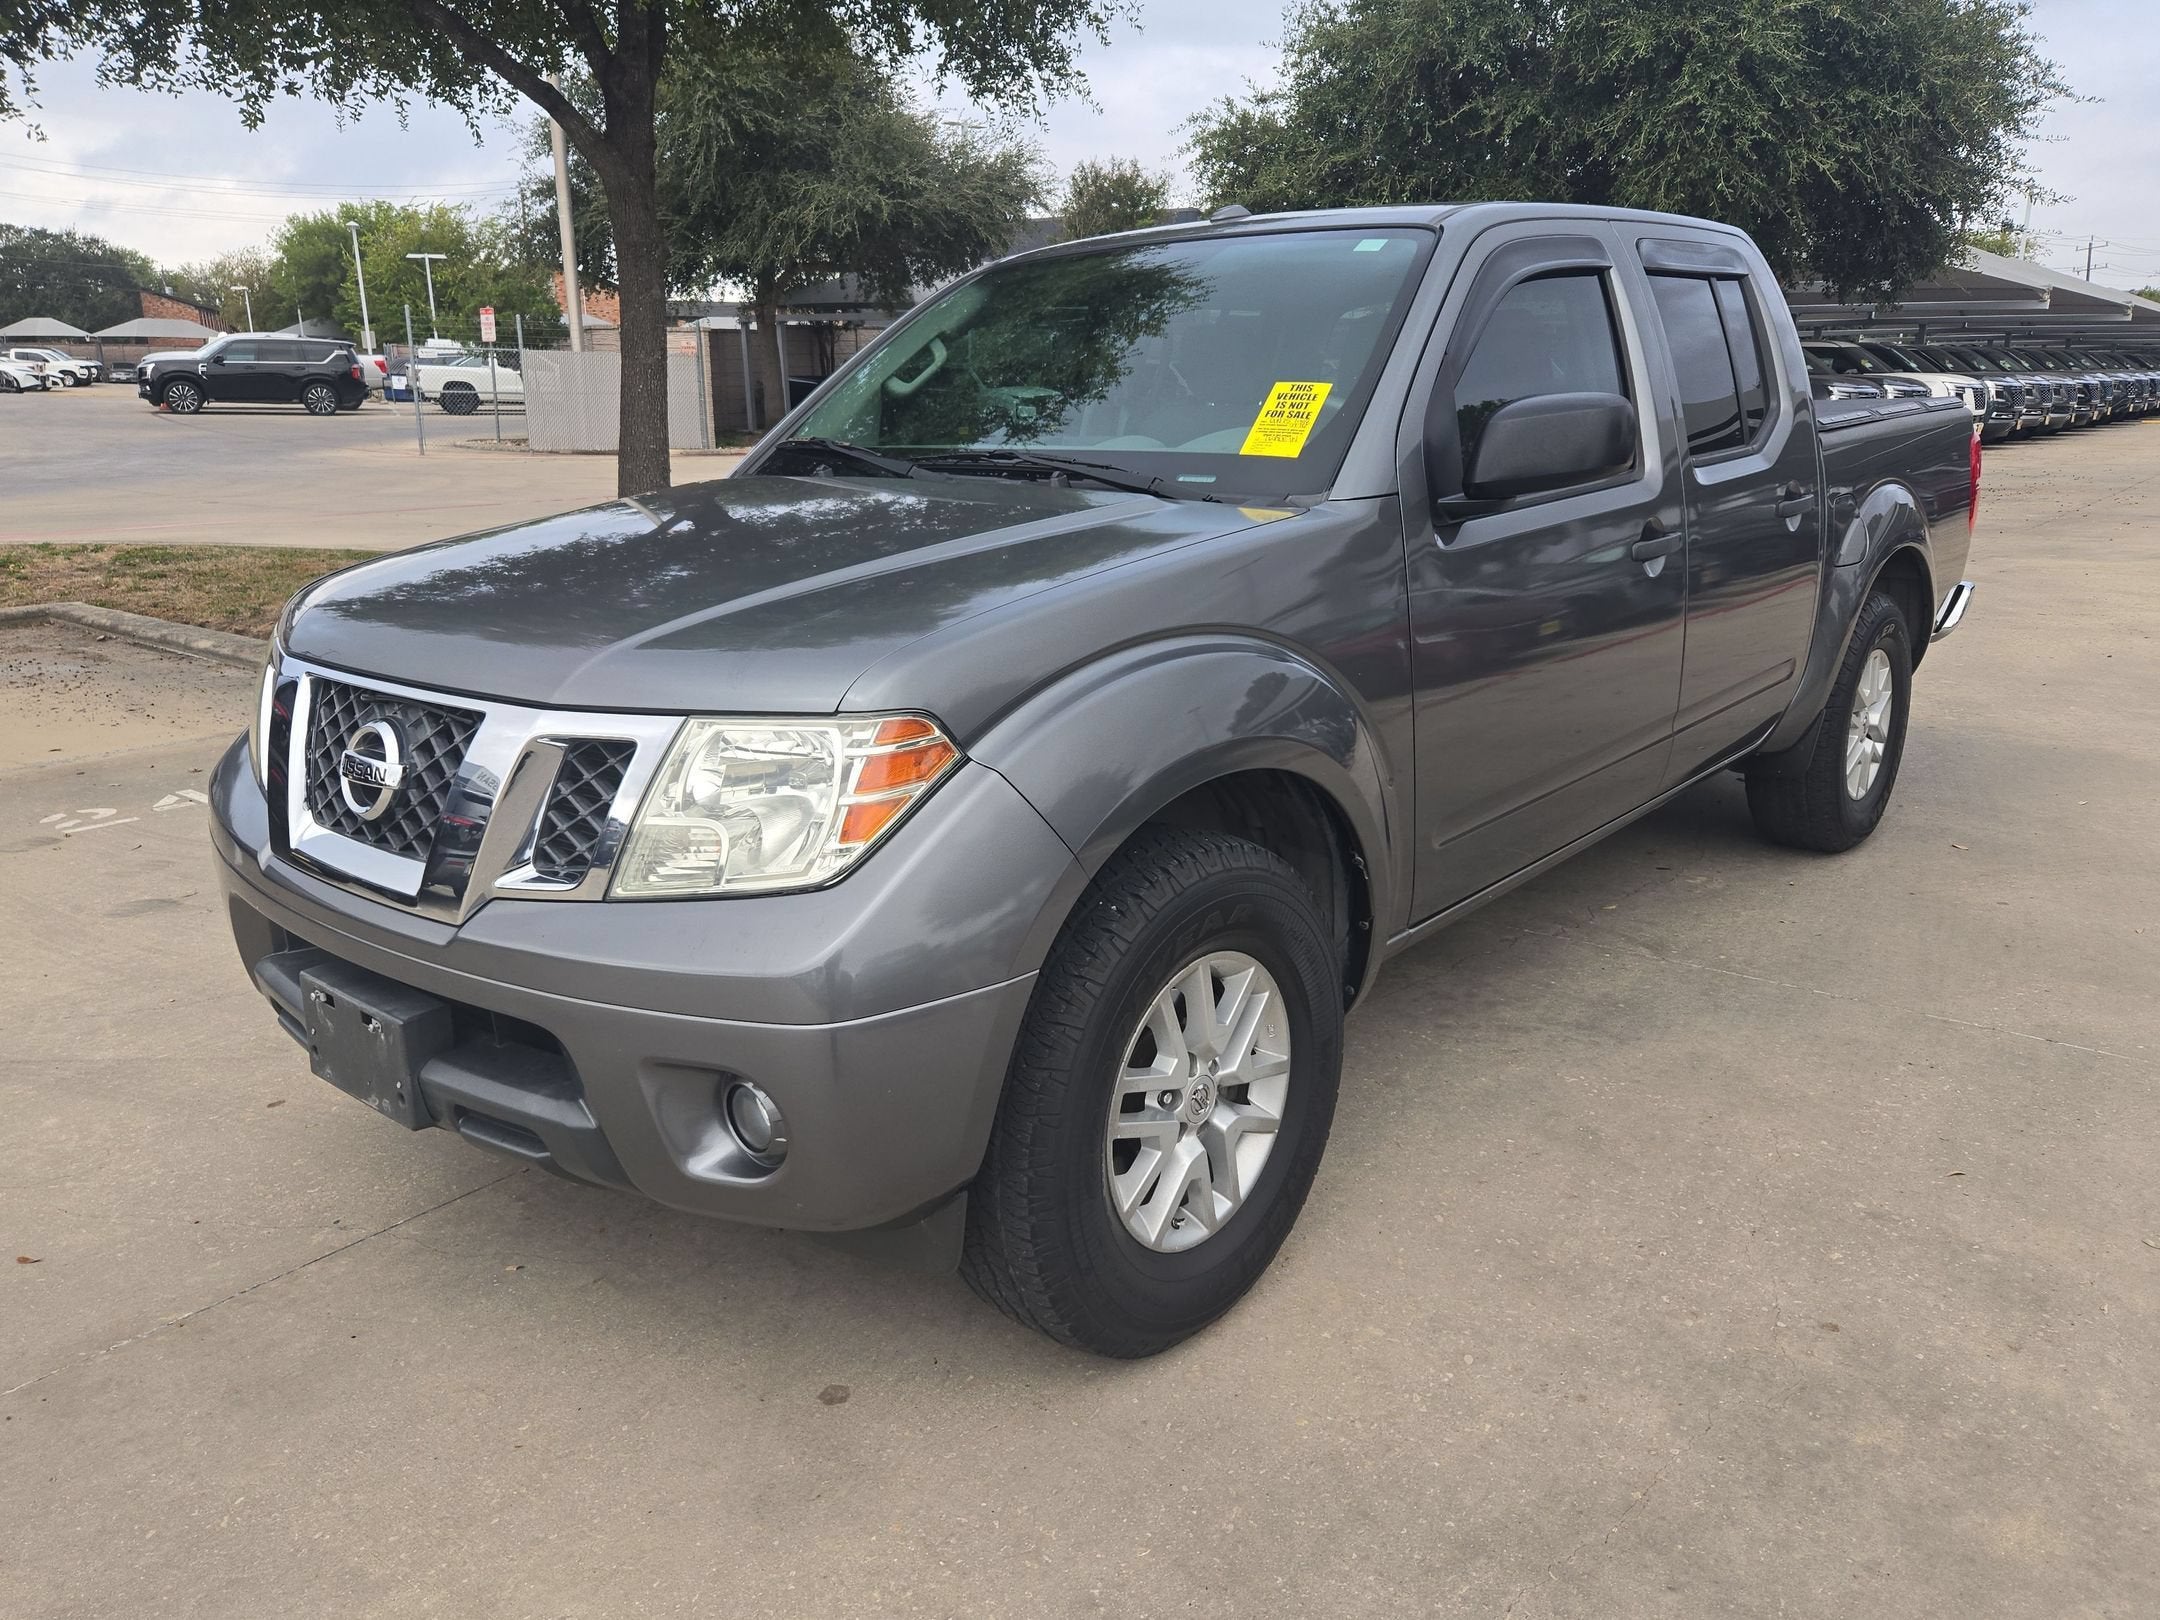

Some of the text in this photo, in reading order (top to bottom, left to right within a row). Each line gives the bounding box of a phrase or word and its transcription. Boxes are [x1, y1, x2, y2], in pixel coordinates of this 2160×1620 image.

[1290, 384, 1314, 392] THIS
[1277, 393, 1318, 401] VEHICLE
[1275, 401, 1287, 409] IS
[1265, 410, 1312, 419] FOR SALE
